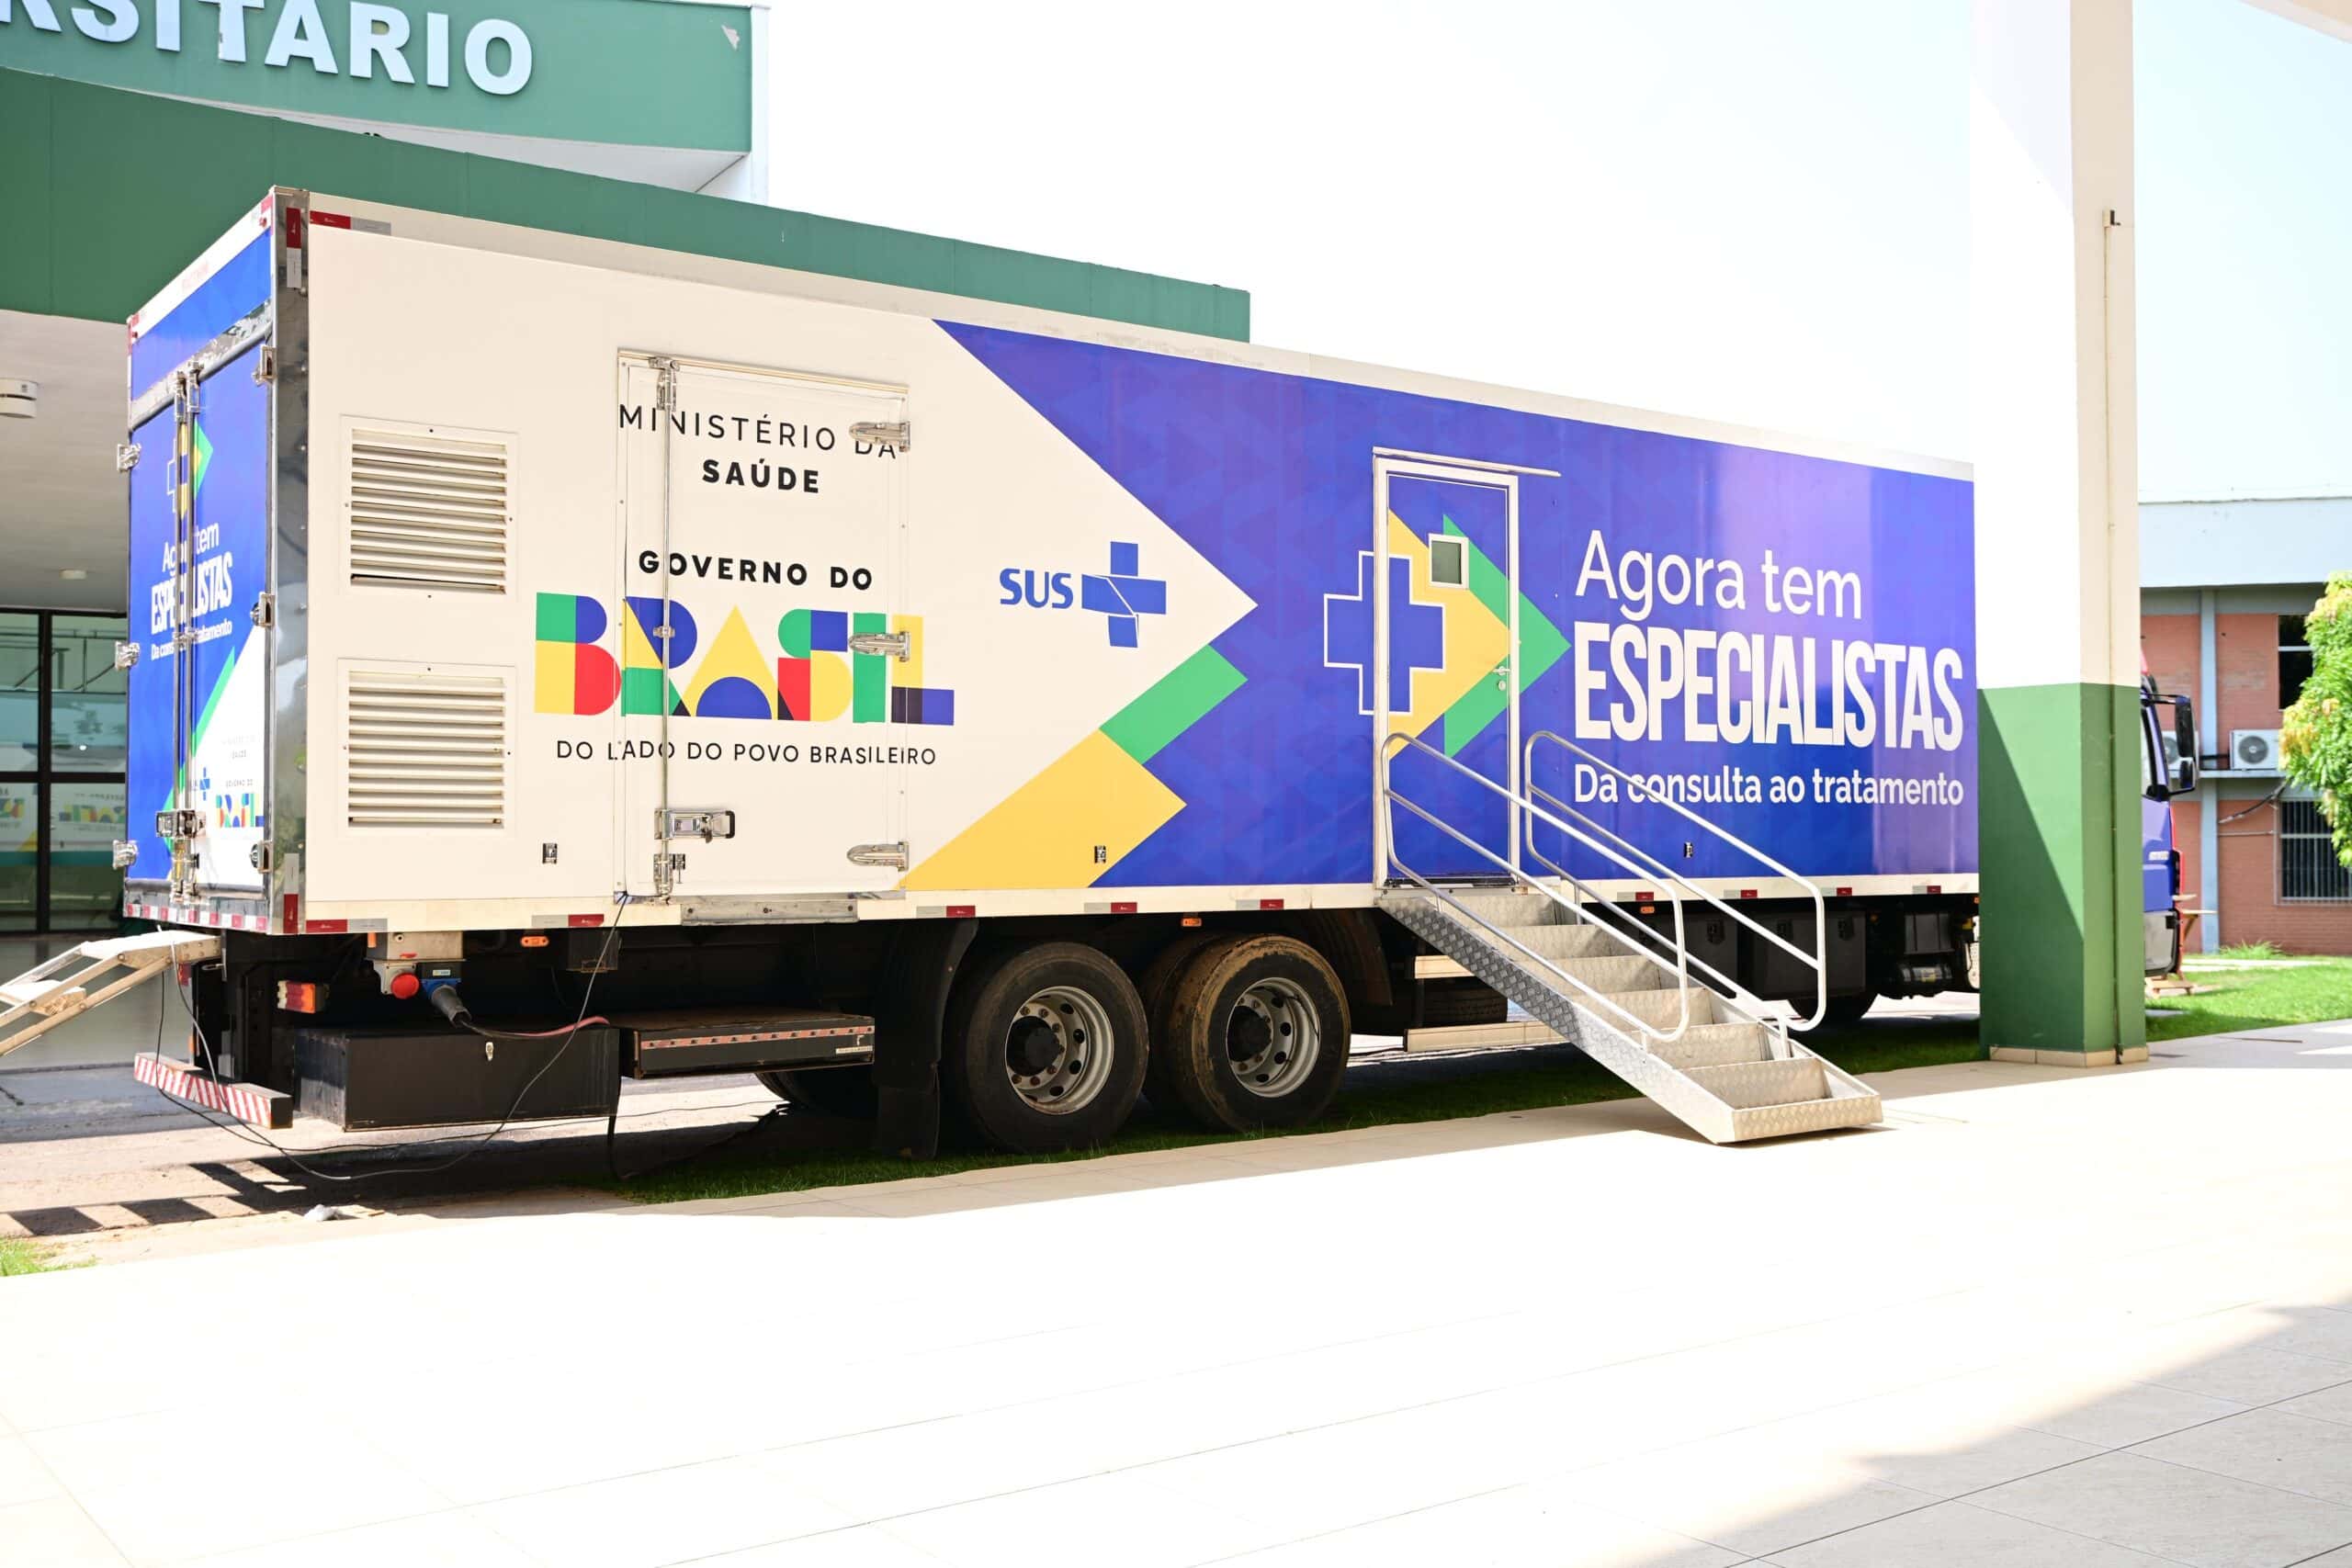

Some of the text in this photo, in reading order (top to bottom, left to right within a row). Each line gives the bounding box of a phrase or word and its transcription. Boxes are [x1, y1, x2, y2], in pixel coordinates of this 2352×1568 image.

[619, 404, 835, 450] MINISTÉRIO
[702, 458, 819, 493] SAÚDE
[639, 550, 872, 591] GOVERNO DO
[1000, 568, 1073, 609] SUS
[1575, 530, 1861, 621] Agora tem
[534, 592, 955, 726] BRASIL
[1574, 621, 1963, 751] ESPECIALISTAS
[557, 739, 935, 765] DO LADO DO POVO BRASILEIRO
[1575, 764, 1963, 806] Da consulta ao tratamento
